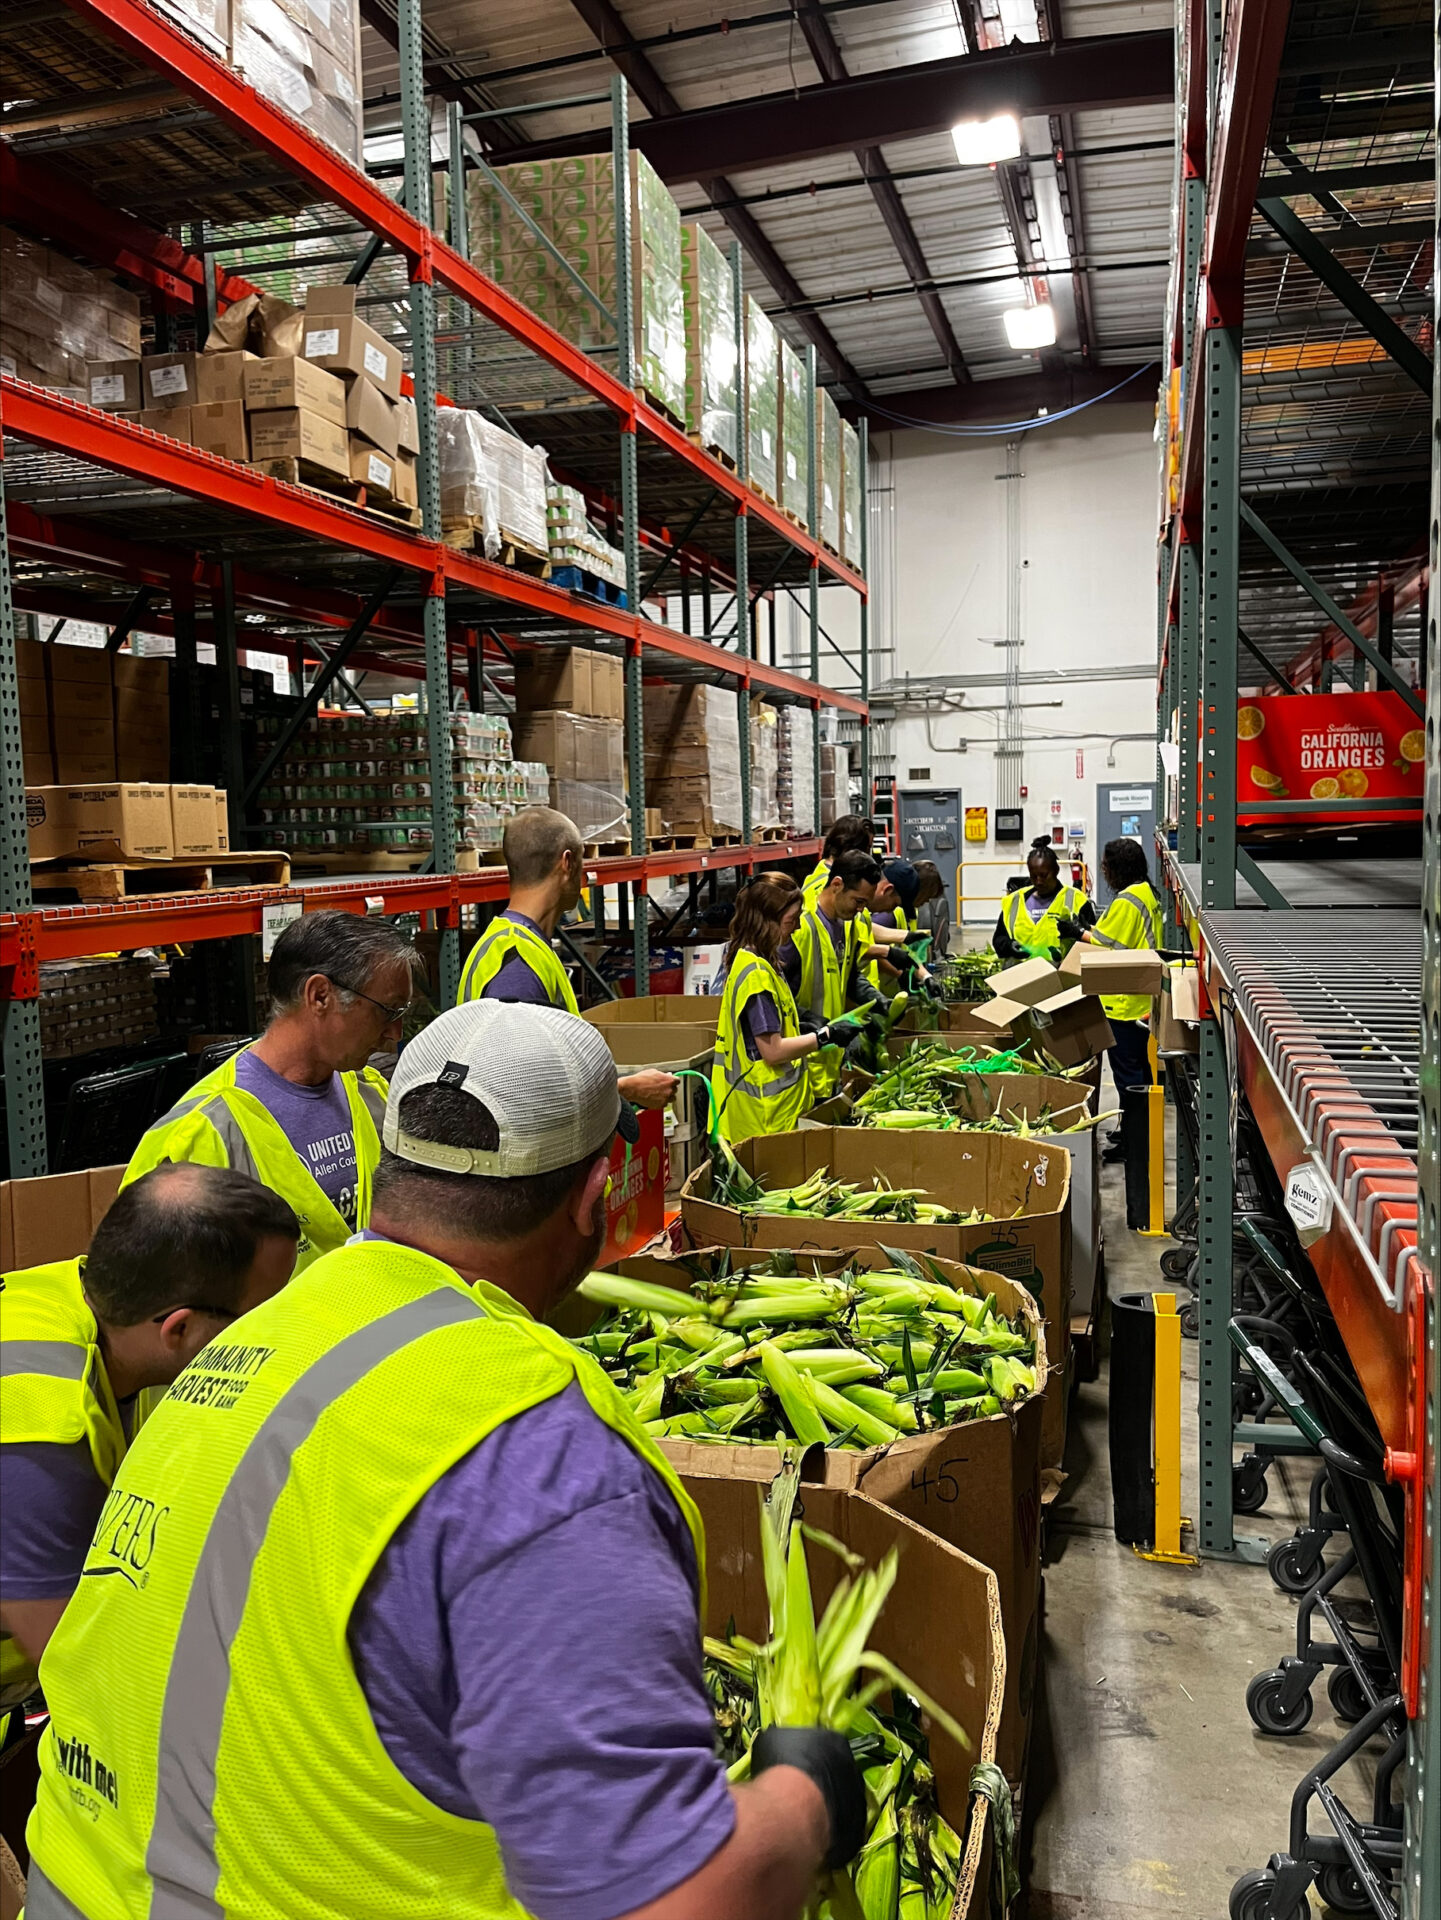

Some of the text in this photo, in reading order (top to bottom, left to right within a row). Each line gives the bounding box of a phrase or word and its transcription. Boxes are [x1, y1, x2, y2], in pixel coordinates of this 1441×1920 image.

[1301, 732, 1384, 749] CALIFORNIA
[1301, 748, 1385, 769] ORANGES
[307, 1132, 352, 1162] UNITED
[315, 1156, 357, 1178] Allen Cou
[1291, 1183, 1318, 1206] gemz
[991, 1225, 1030, 1246] 45
[911, 1458, 969, 1505] 45
[58, 1735, 92, 1787] with
[95, 1759, 118, 1810] me!
